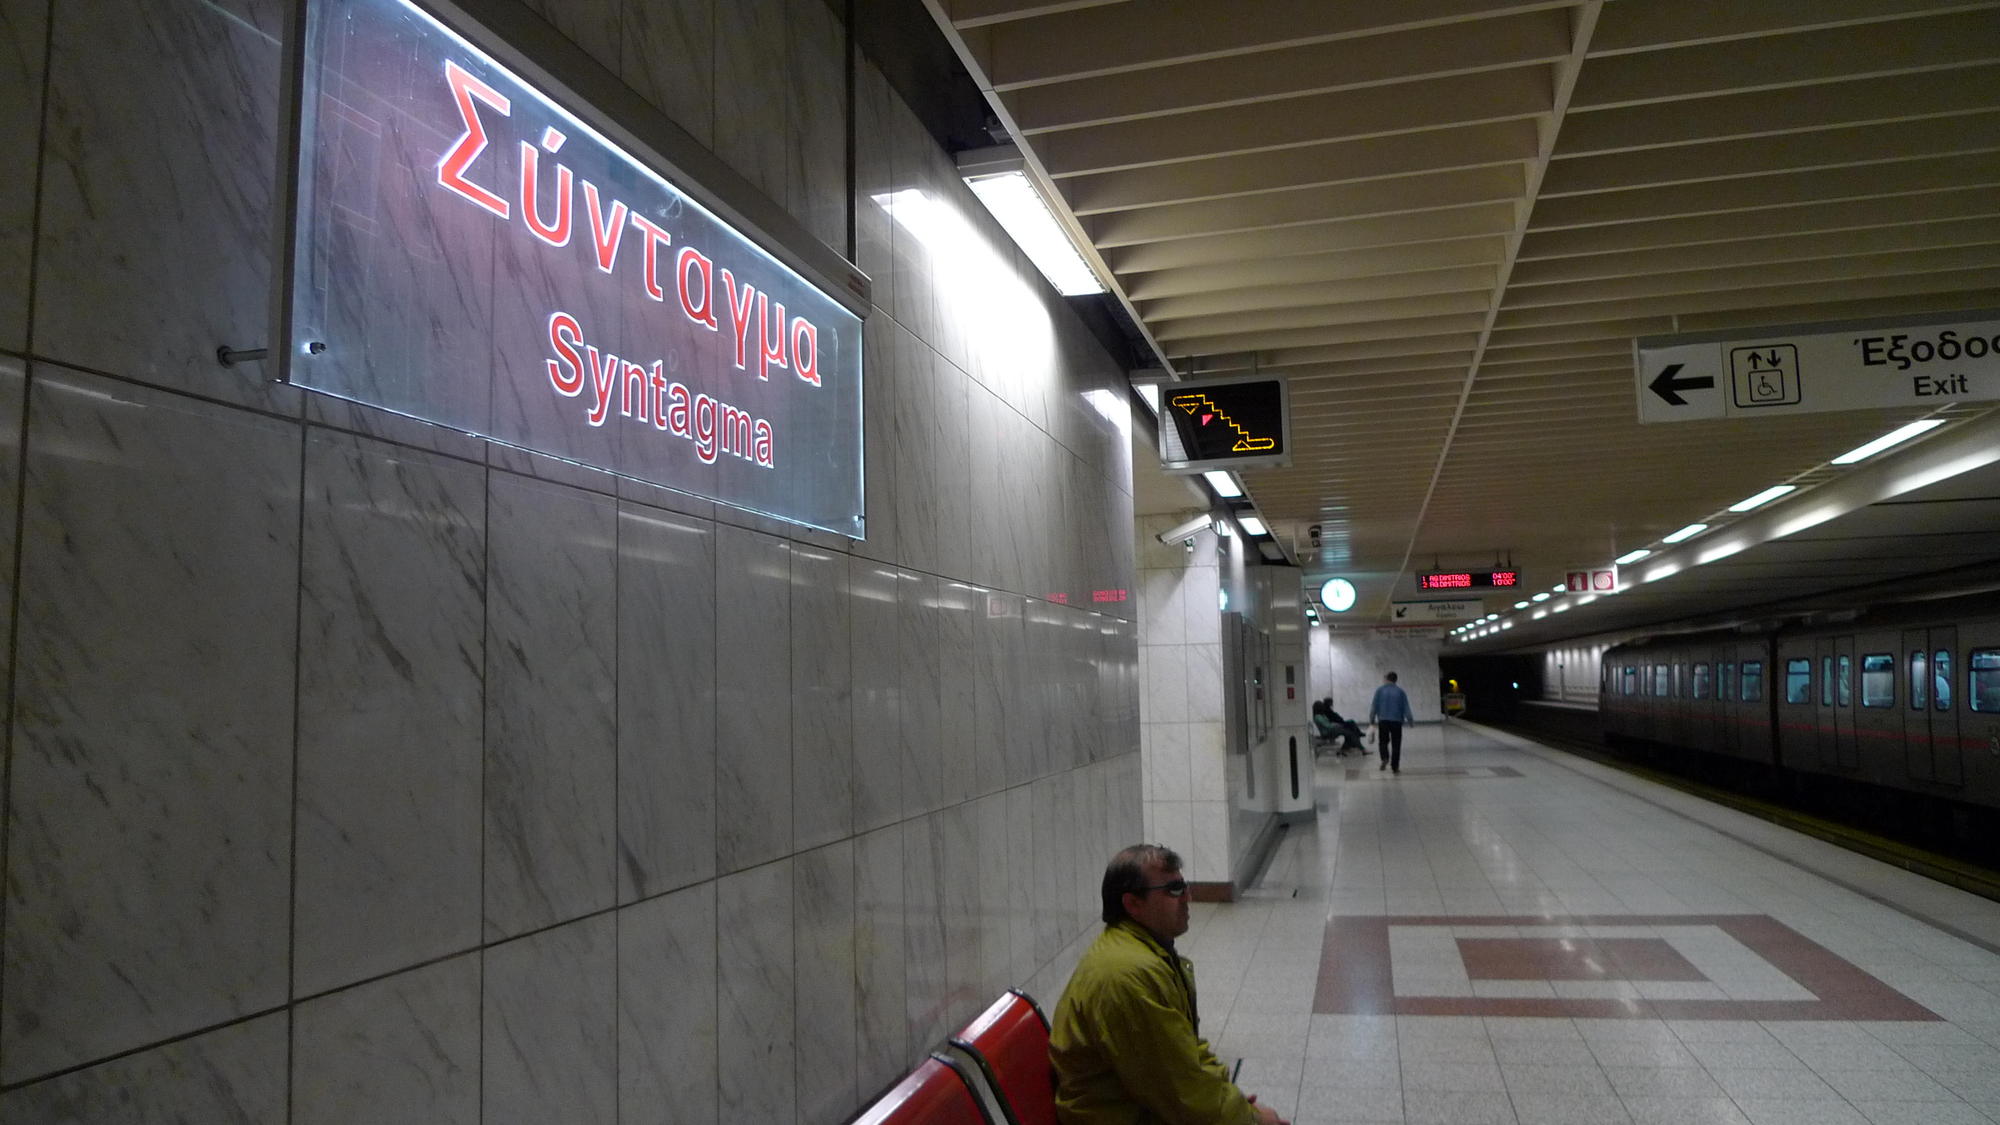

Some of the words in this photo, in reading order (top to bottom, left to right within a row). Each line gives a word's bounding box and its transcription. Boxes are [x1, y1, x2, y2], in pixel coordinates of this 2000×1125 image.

[437, 58, 822, 387] Σύνταγμα
[546, 311, 775, 468] Syntagma
[1913, 373, 1969, 396] Exit
